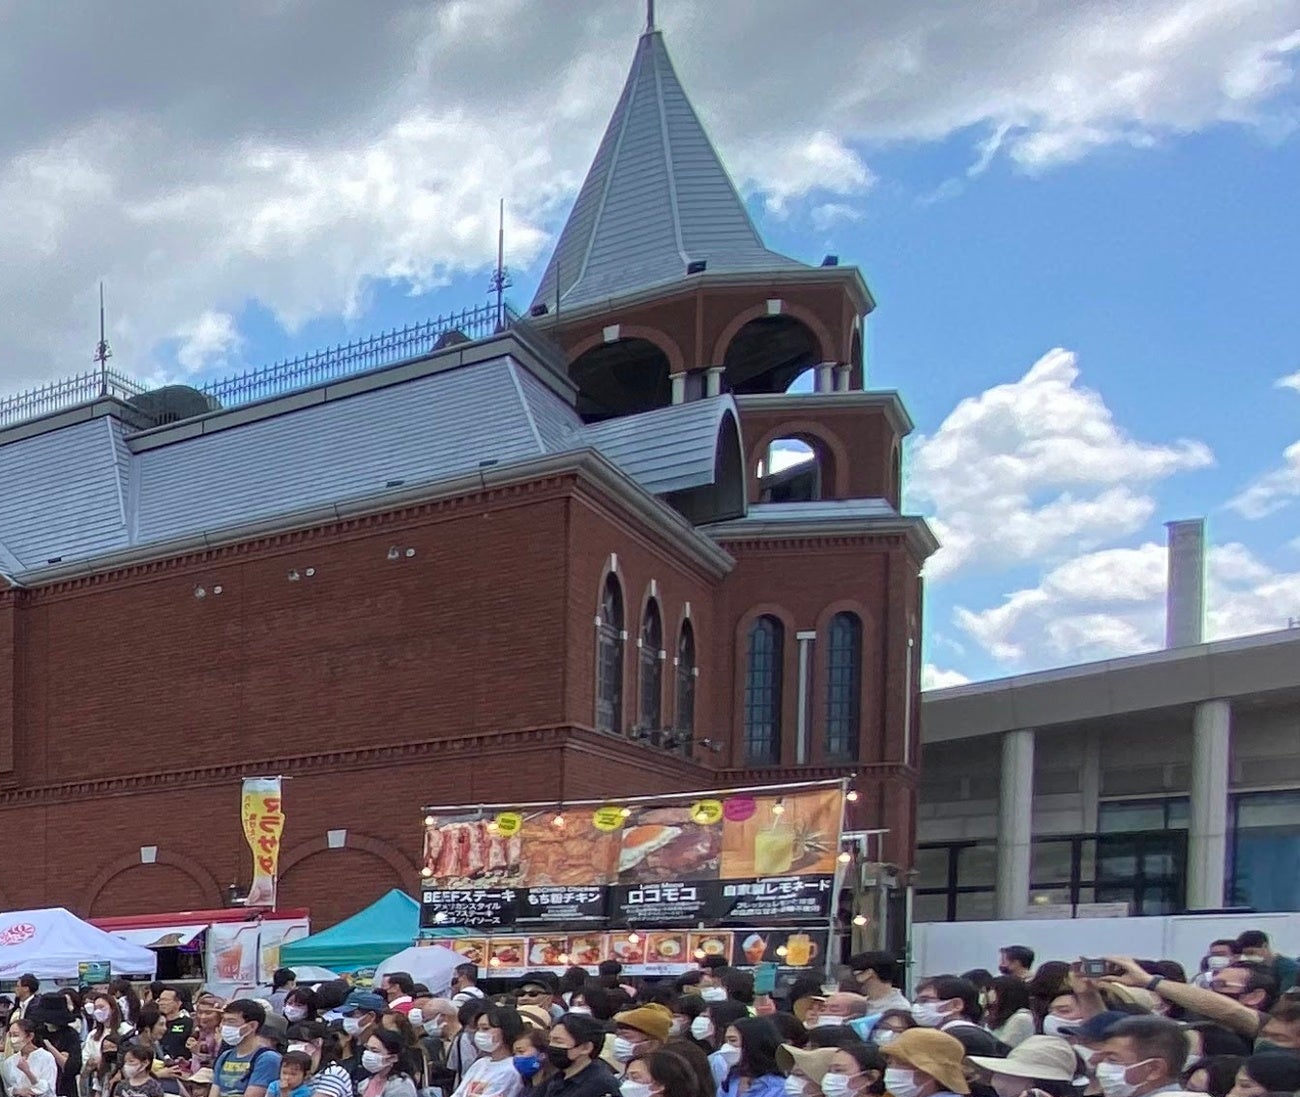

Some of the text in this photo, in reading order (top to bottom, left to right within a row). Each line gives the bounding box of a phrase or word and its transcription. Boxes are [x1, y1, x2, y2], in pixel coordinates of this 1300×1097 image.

[723, 879, 831, 896] 自家製レモネード
[423, 889, 516, 903] BEEFステーキ
[528, 892, 601, 905] もち粉チキン
[628, 887, 696, 904] ロコモコ
